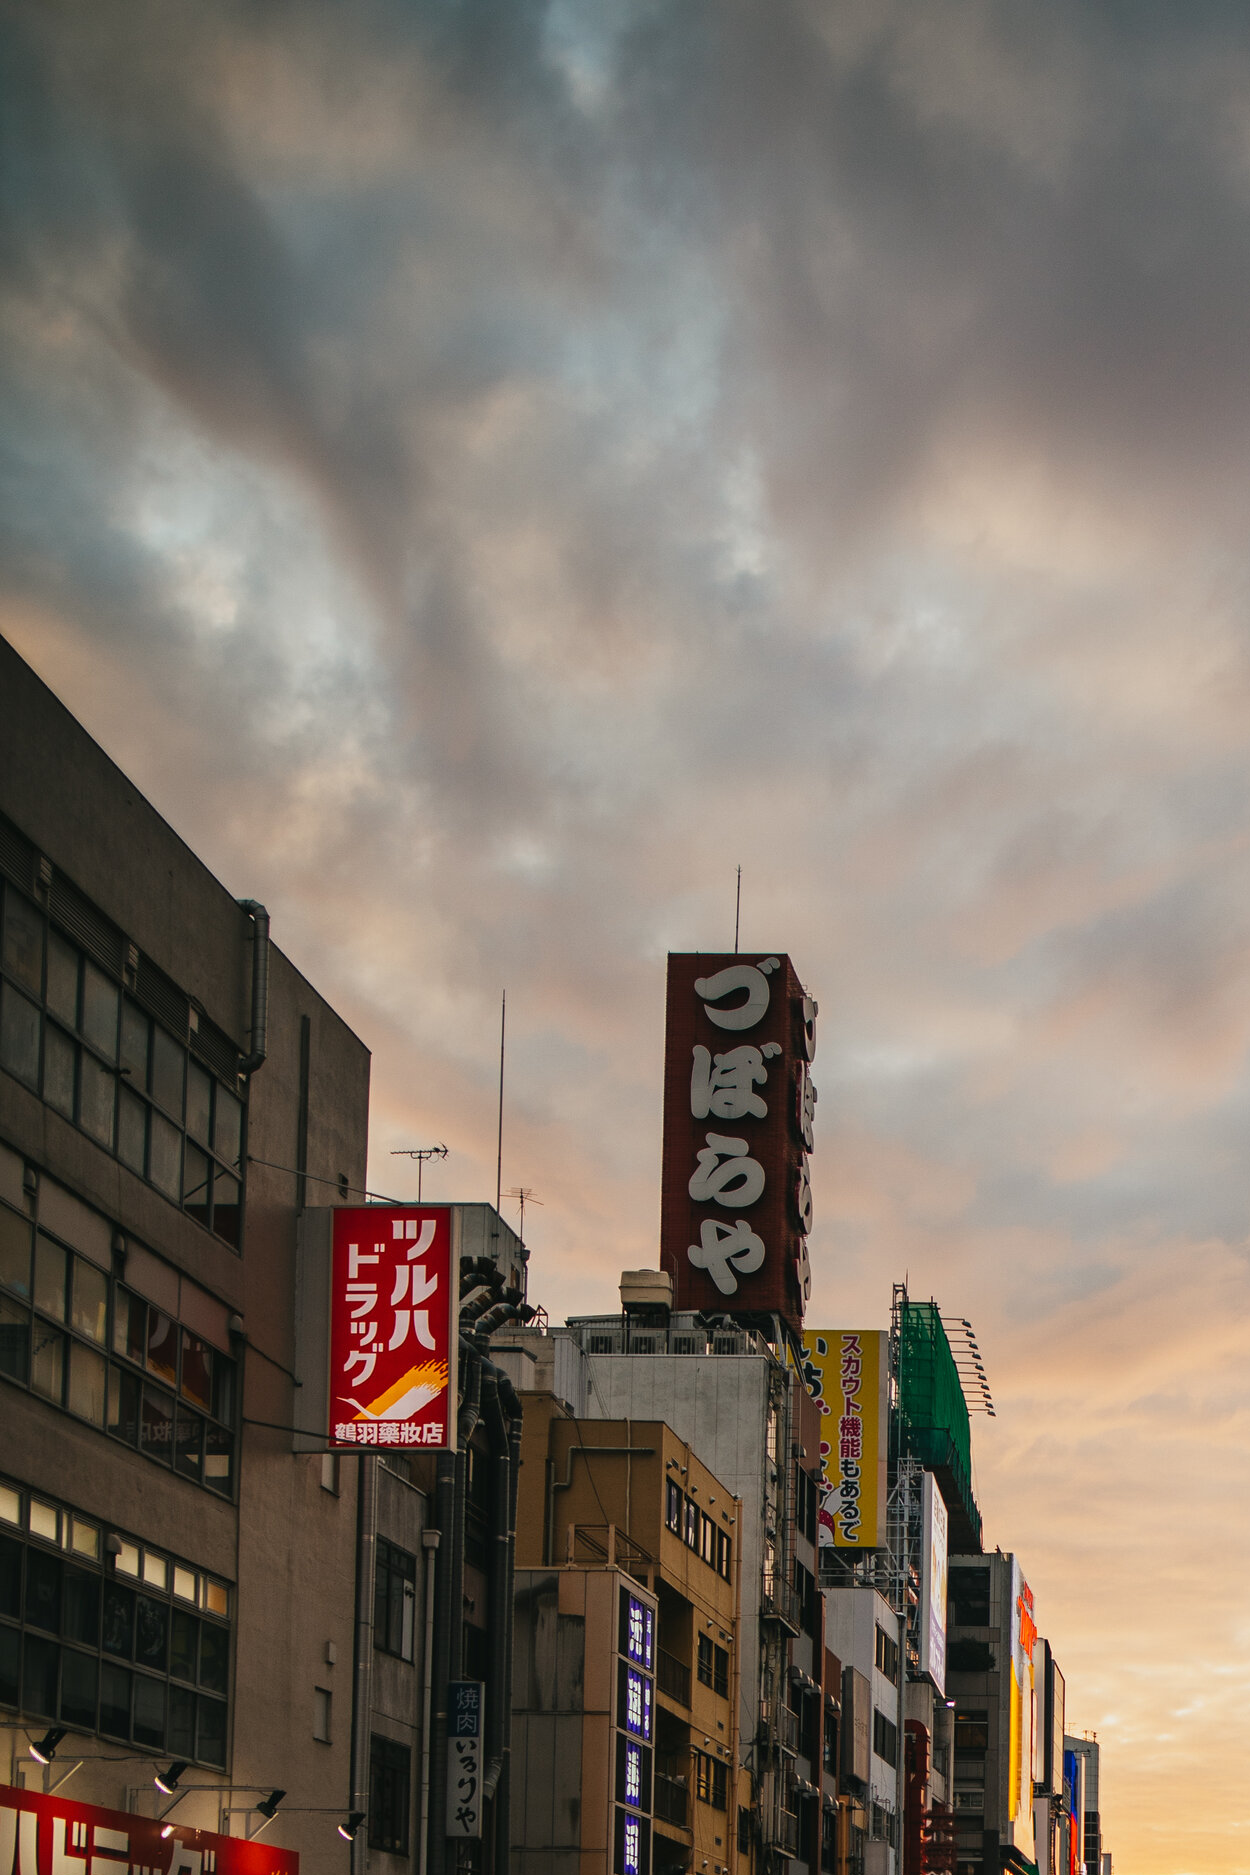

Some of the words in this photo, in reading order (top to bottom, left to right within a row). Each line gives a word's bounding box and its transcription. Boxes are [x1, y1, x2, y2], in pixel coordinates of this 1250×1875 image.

[688, 957, 783, 1294] づぼらや
[343, 1243, 385, 1387] ドラッグ
[389, 1219, 438, 1351] ツルハ
[840, 1334, 861, 1541] スカウト機能もあるで
[456, 1688, 478, 1734] 焼肉
